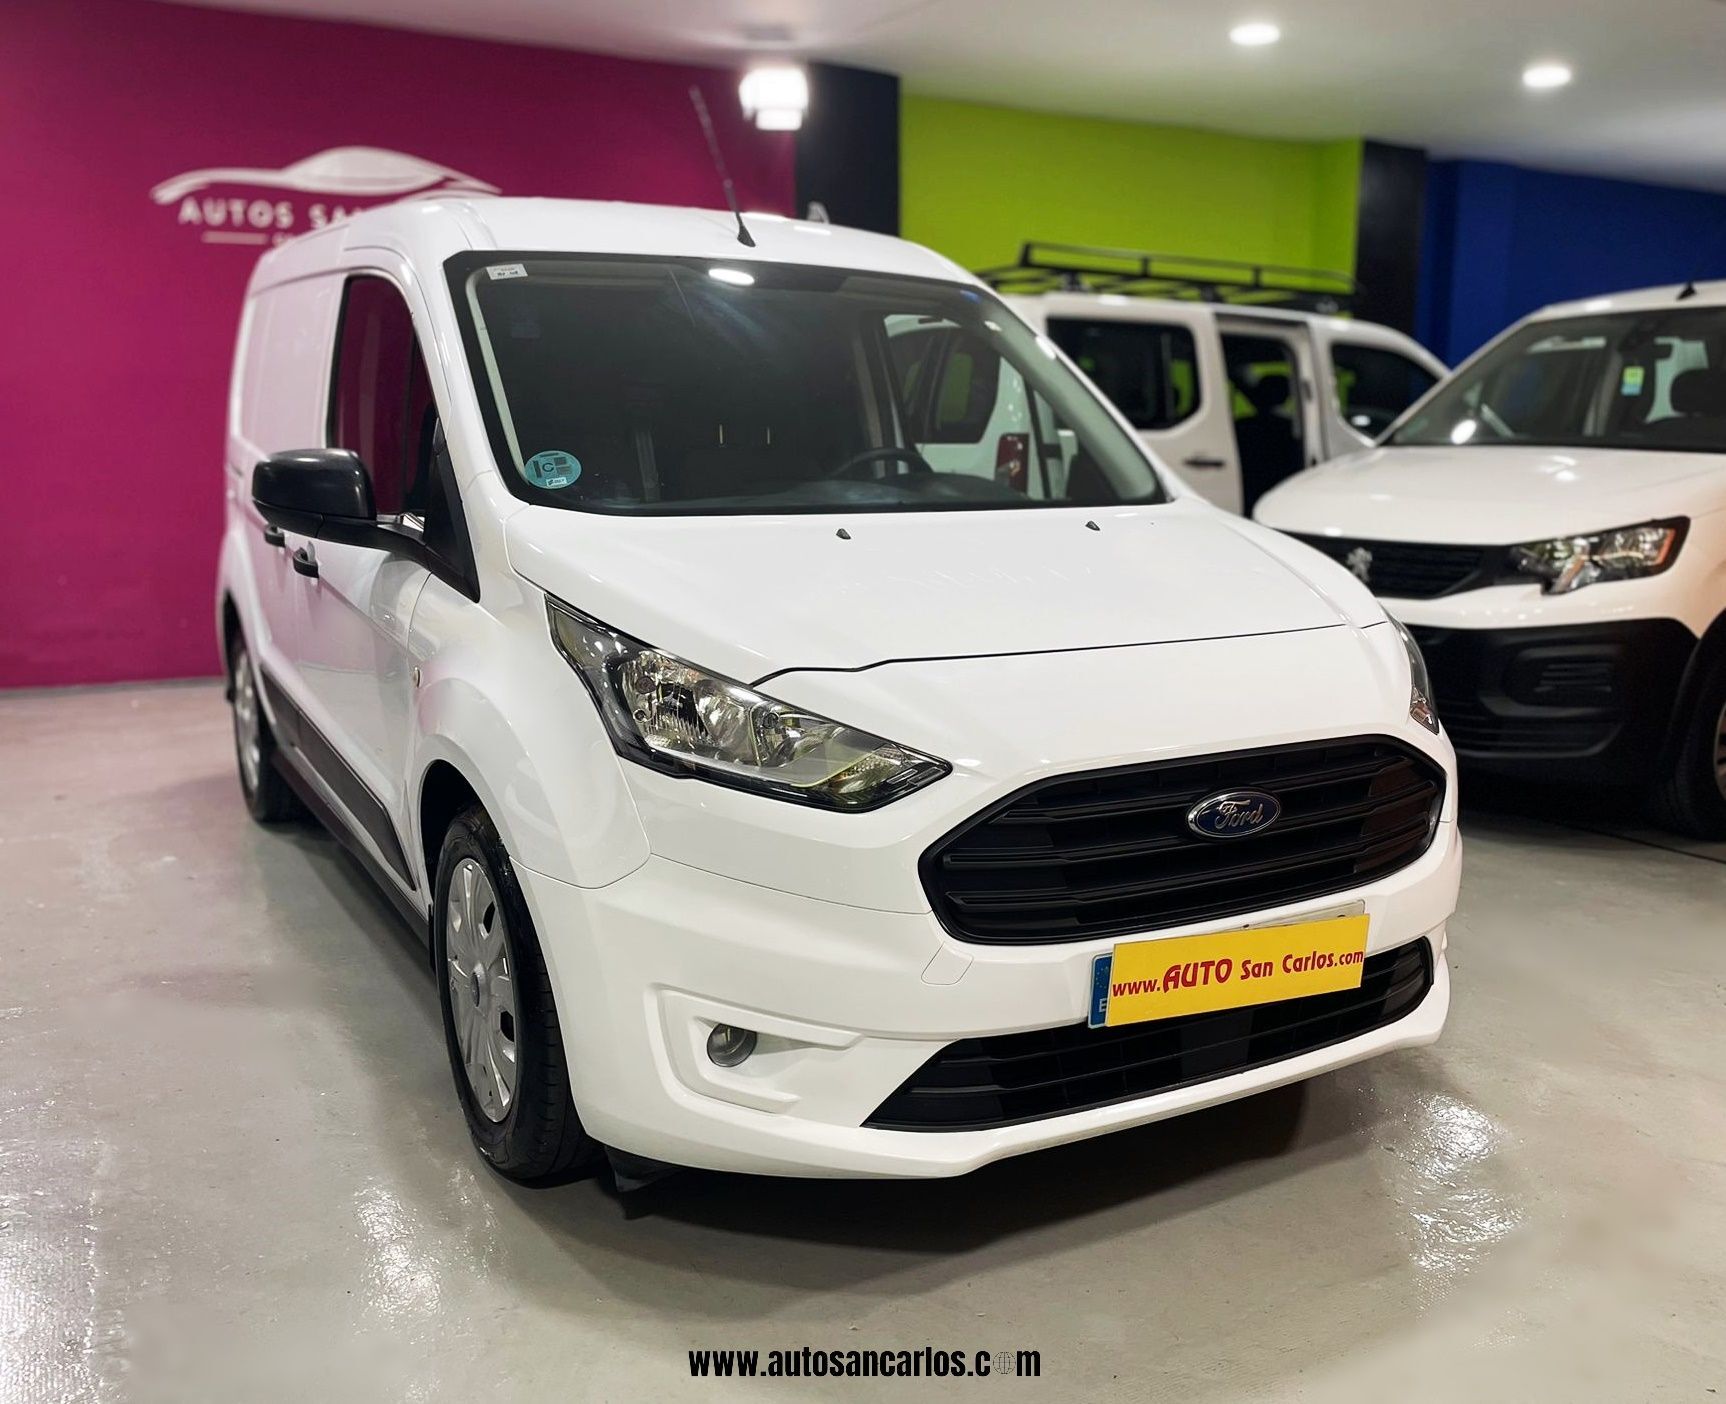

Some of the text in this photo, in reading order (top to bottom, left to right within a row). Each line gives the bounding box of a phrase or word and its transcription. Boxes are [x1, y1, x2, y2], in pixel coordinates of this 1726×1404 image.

[177, 196, 363, 230] AUTOS SA
[1214, 799, 1264, 829] Ford
[1240, 959, 1274, 981] San
[1282, 950, 1364, 974] Carlos.com
